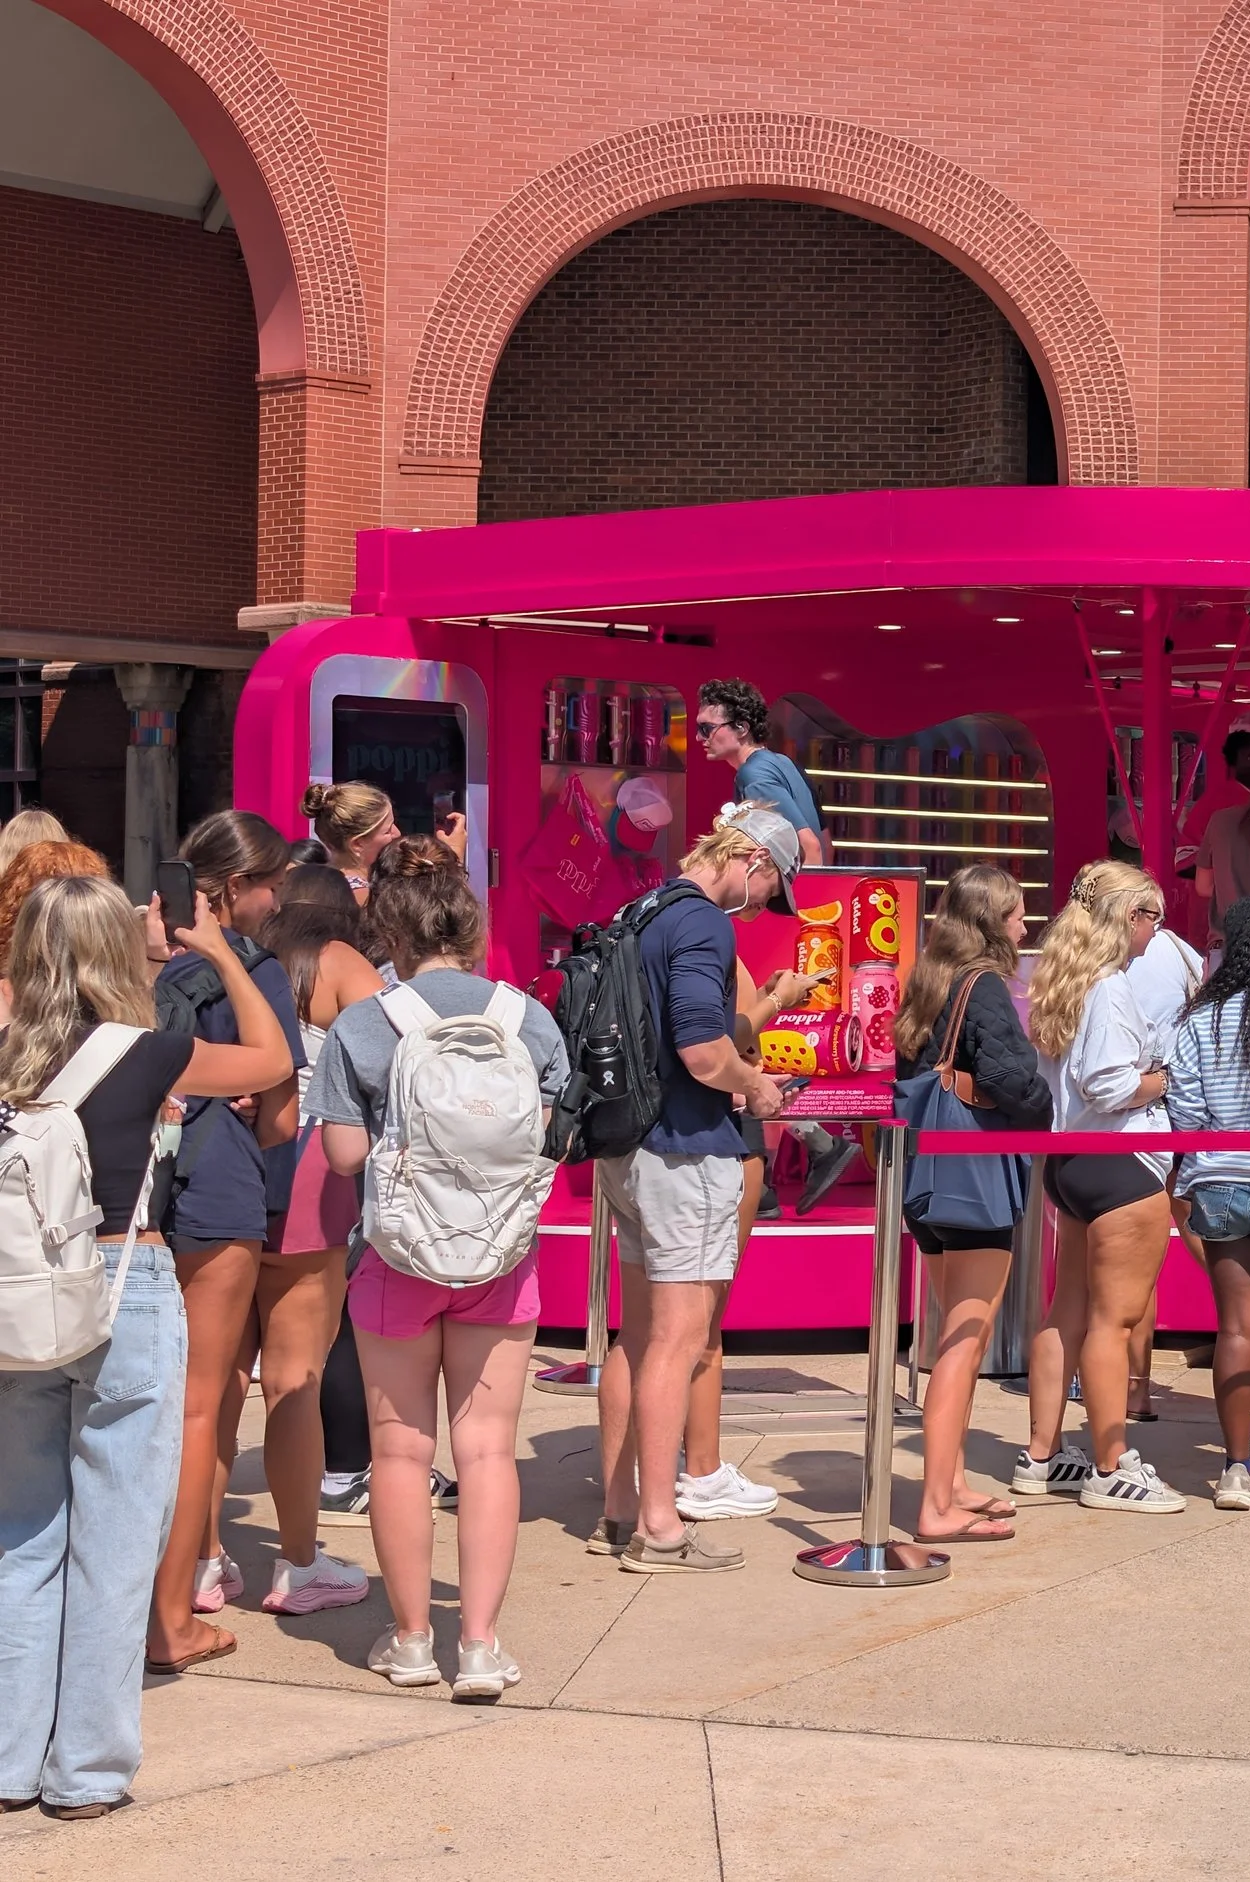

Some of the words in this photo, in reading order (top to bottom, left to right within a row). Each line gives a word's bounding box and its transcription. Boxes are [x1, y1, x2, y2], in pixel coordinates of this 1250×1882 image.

[347, 741, 449, 782] poppi
[851, 896, 861, 935] poppi
[797, 941, 808, 974] oppi
[775, 1011, 826, 1026] poppi
